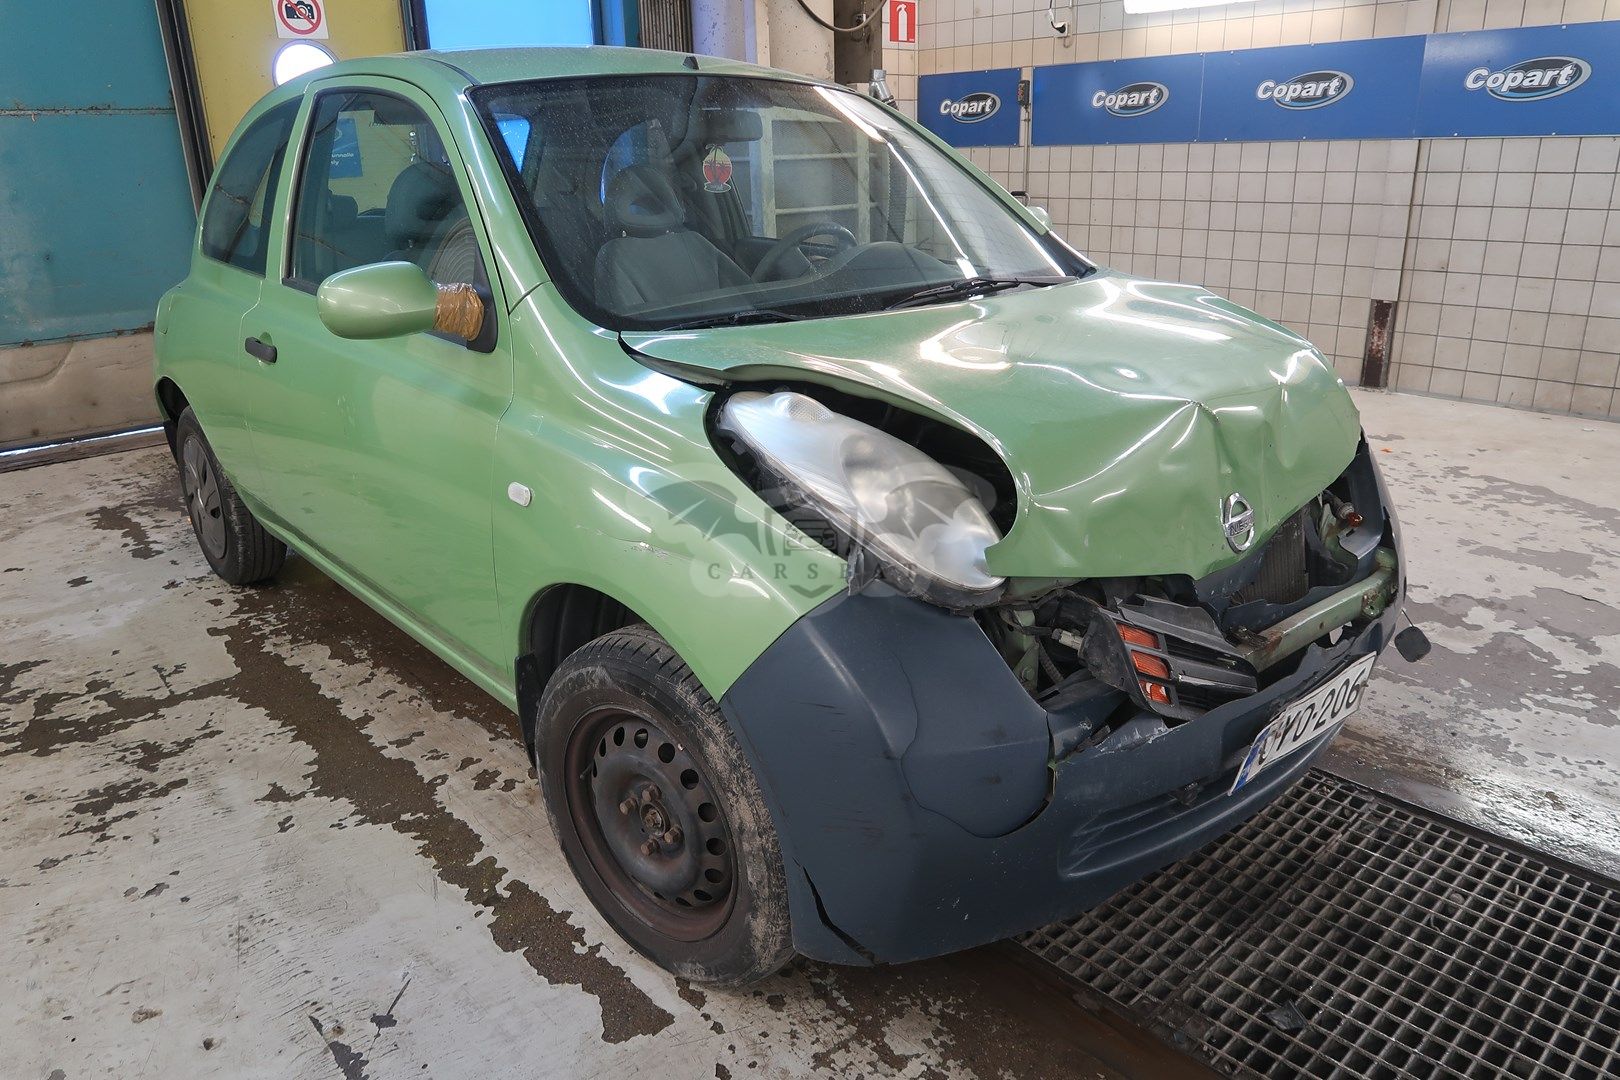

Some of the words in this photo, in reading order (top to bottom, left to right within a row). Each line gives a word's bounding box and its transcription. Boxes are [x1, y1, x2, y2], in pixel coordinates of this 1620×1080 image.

[1256, 77, 1340, 102] Copart
[1464, 64, 1574, 92] Copart
[940, 98, 993, 117] Copart
[1091, 88, 1159, 110] Copart
